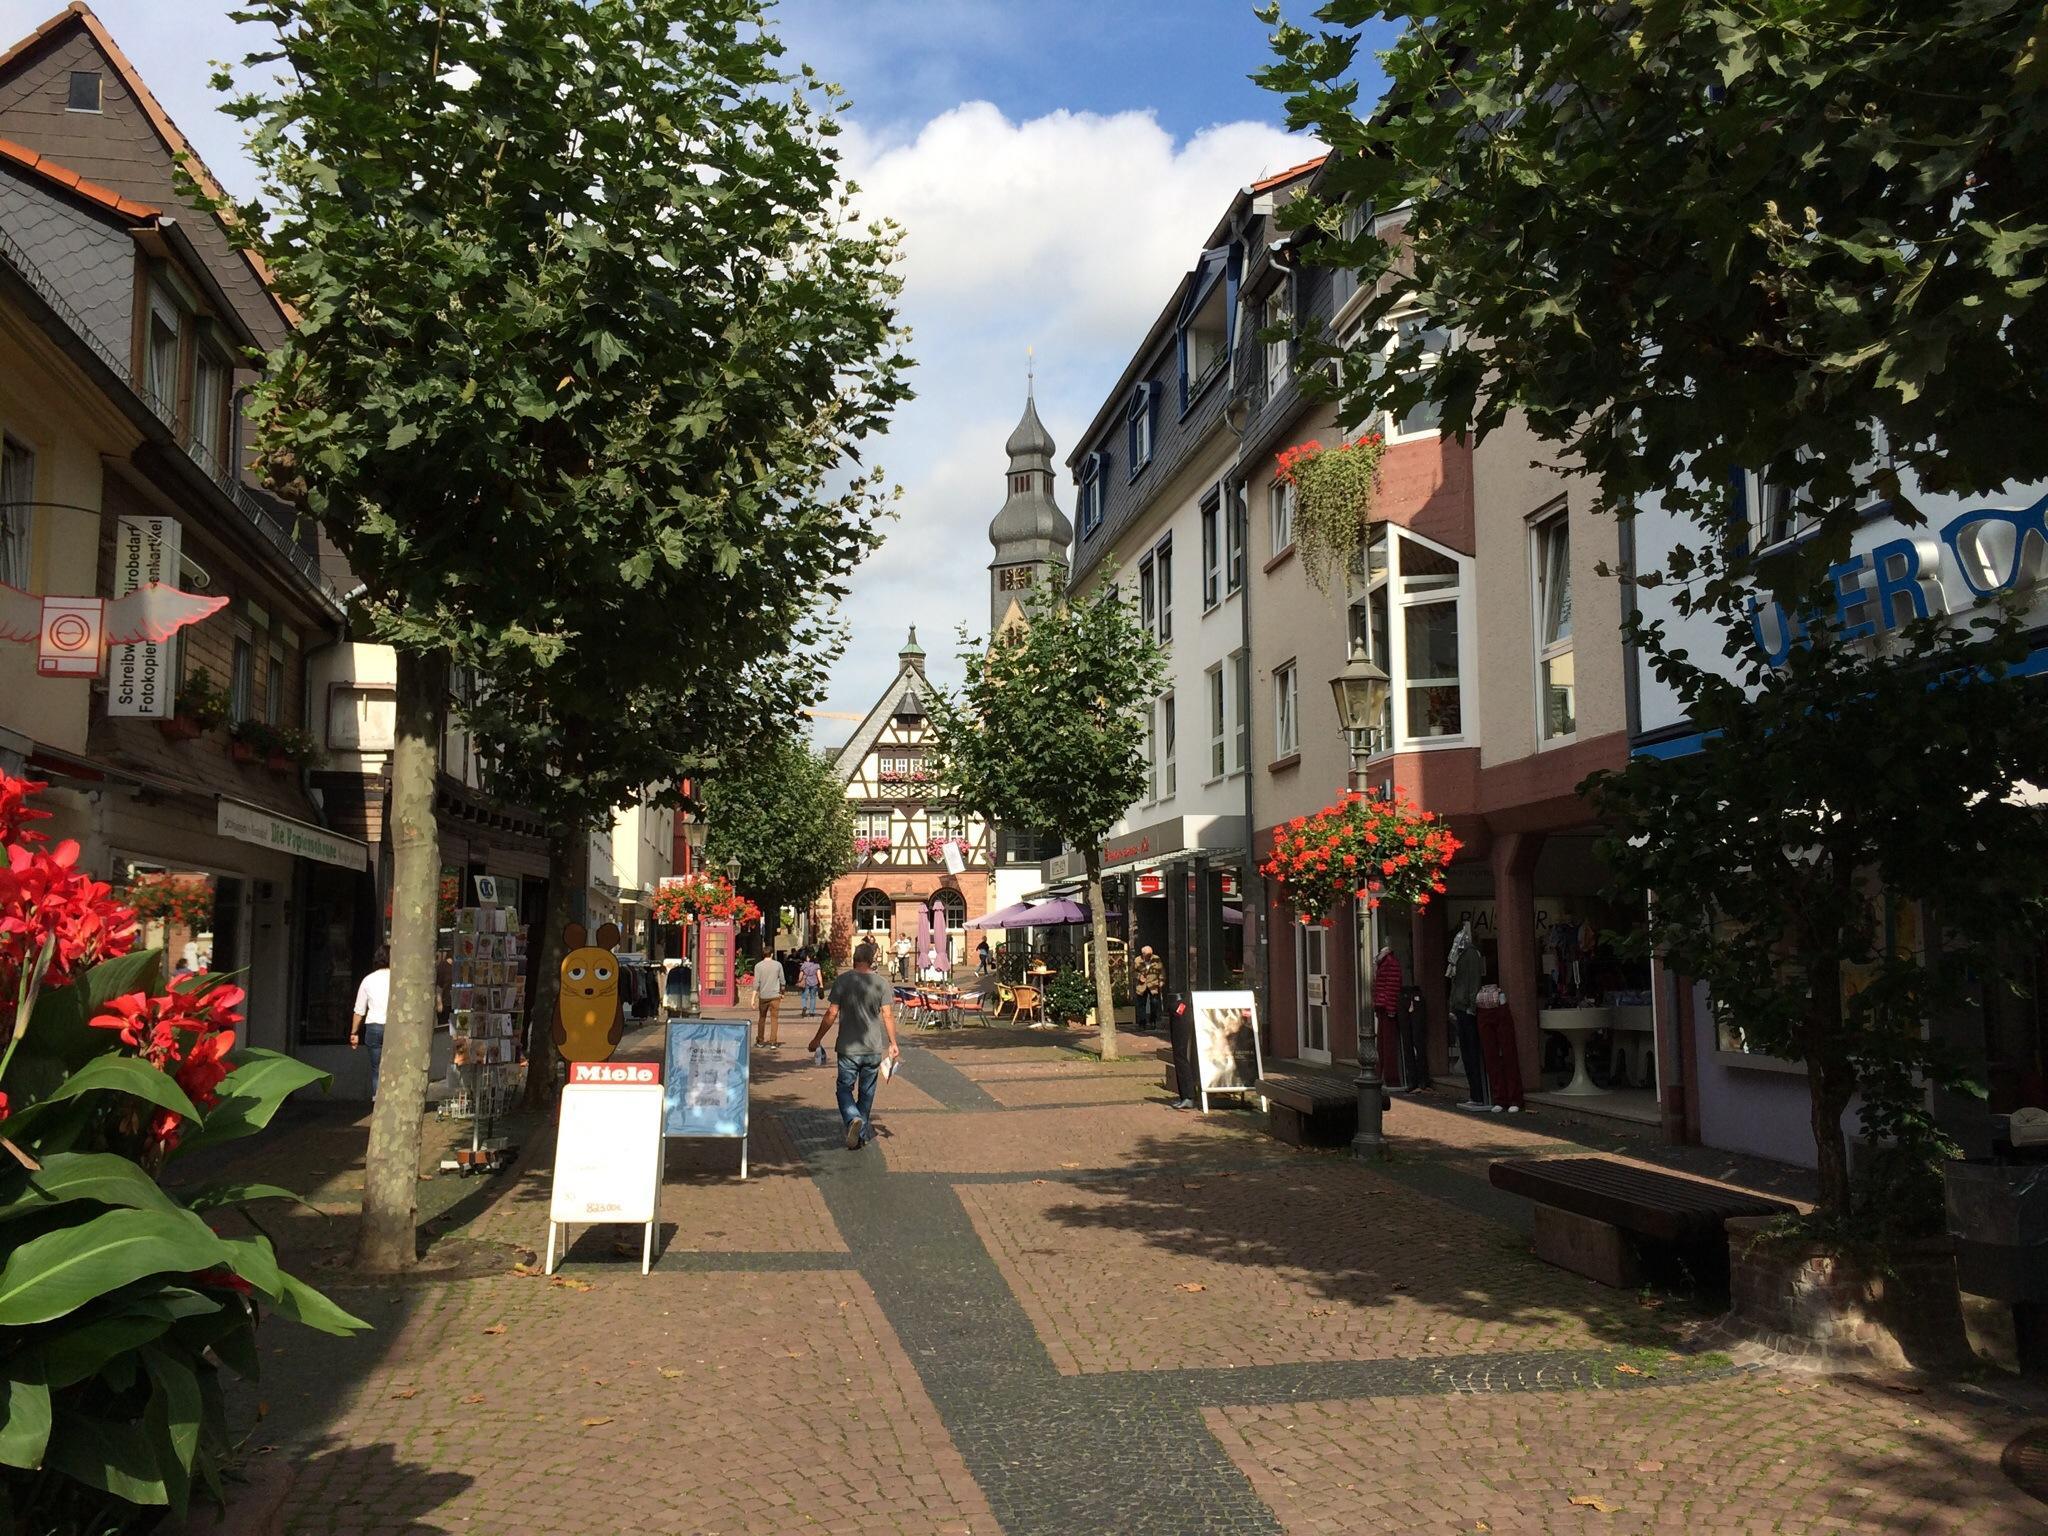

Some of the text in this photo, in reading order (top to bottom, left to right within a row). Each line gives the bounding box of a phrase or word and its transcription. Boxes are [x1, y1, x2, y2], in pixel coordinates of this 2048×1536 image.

[146, 519, 163, 584] enkartikel
[118, 525, 140, 706] Schreibw ürobedarf
[576, 1065, 653, 1082] Miele
